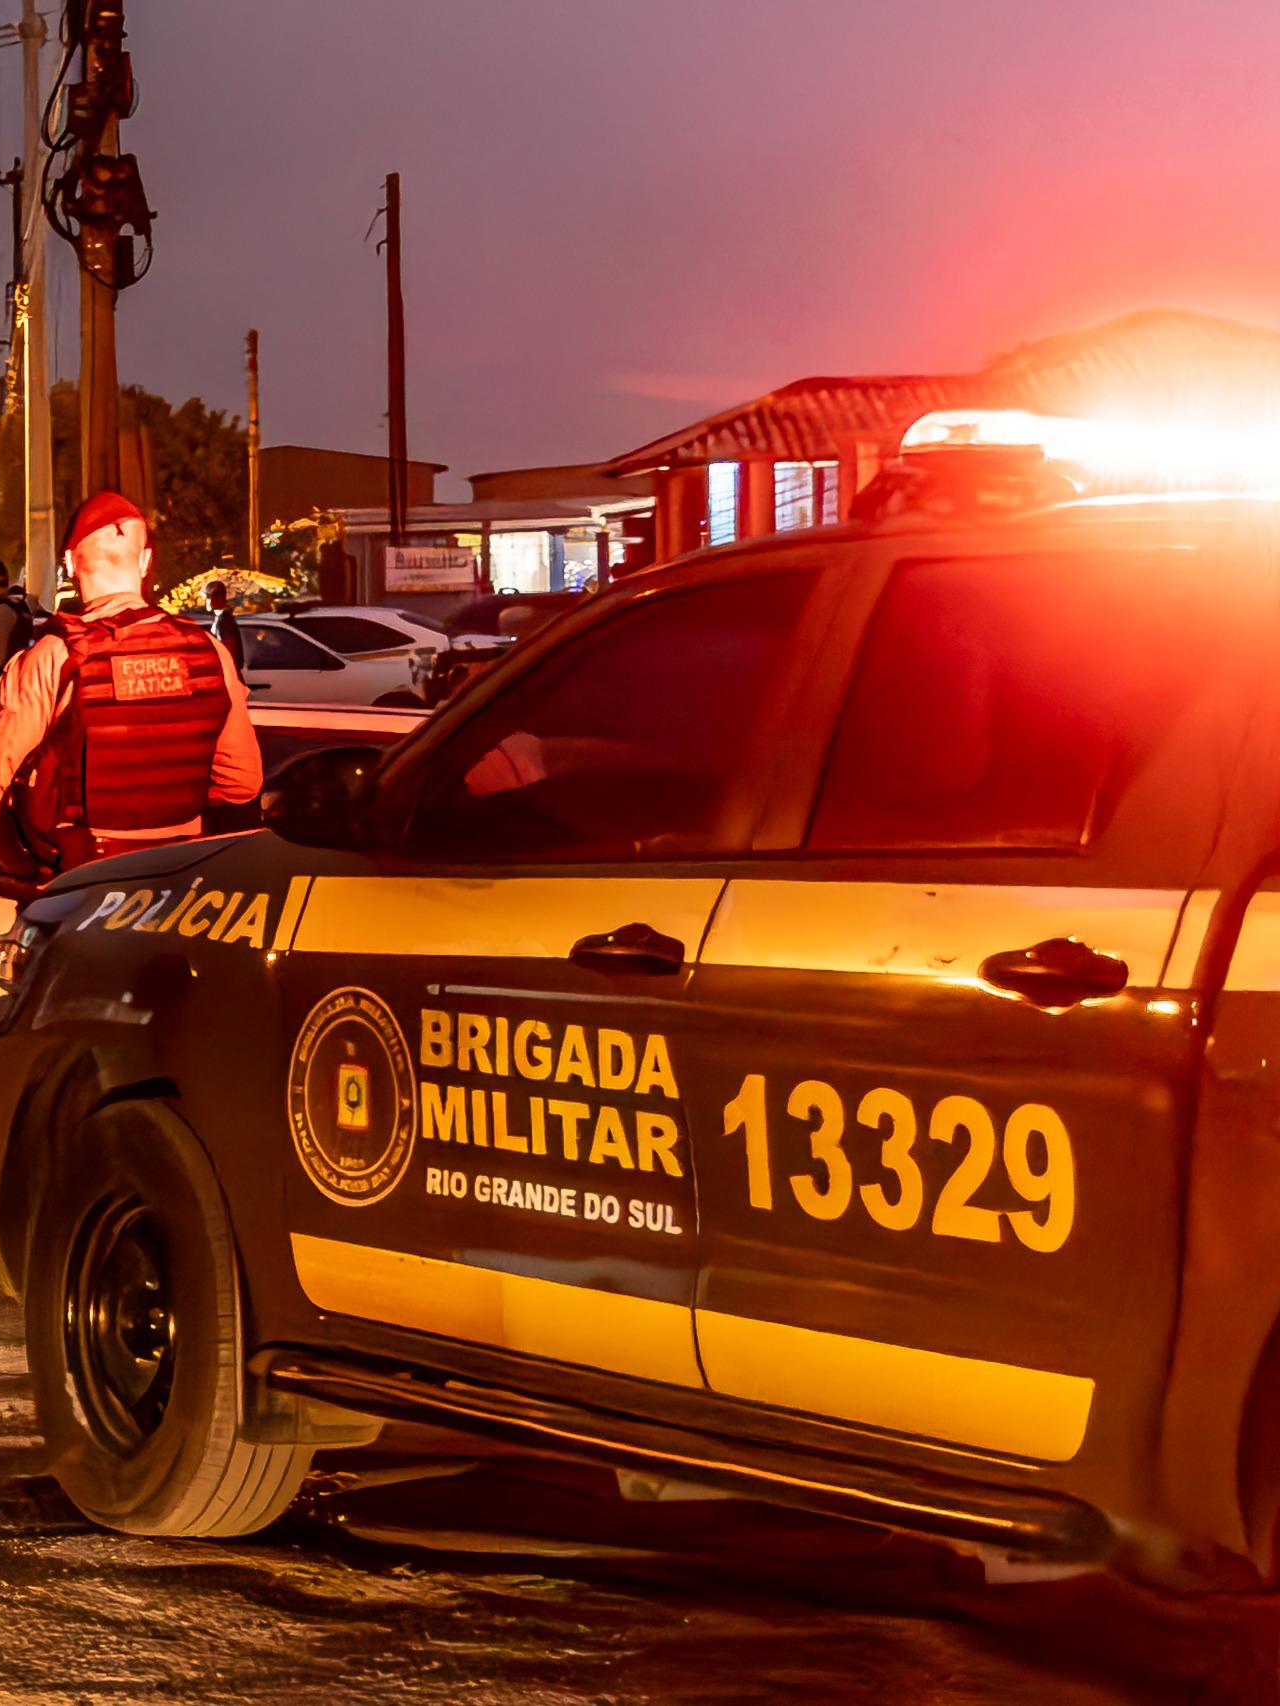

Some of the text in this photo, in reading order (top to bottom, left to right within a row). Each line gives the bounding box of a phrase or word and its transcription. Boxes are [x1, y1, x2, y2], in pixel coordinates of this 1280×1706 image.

[76, 877, 269, 949] POLÍCIA
[420, 1008, 679, 1099] BRIGADA
[420, 1081, 683, 1177] MILITAR
[723, 1073, 1075, 1253] 13329
[426, 1167, 682, 1235] RIO GRANDE DO SUL
